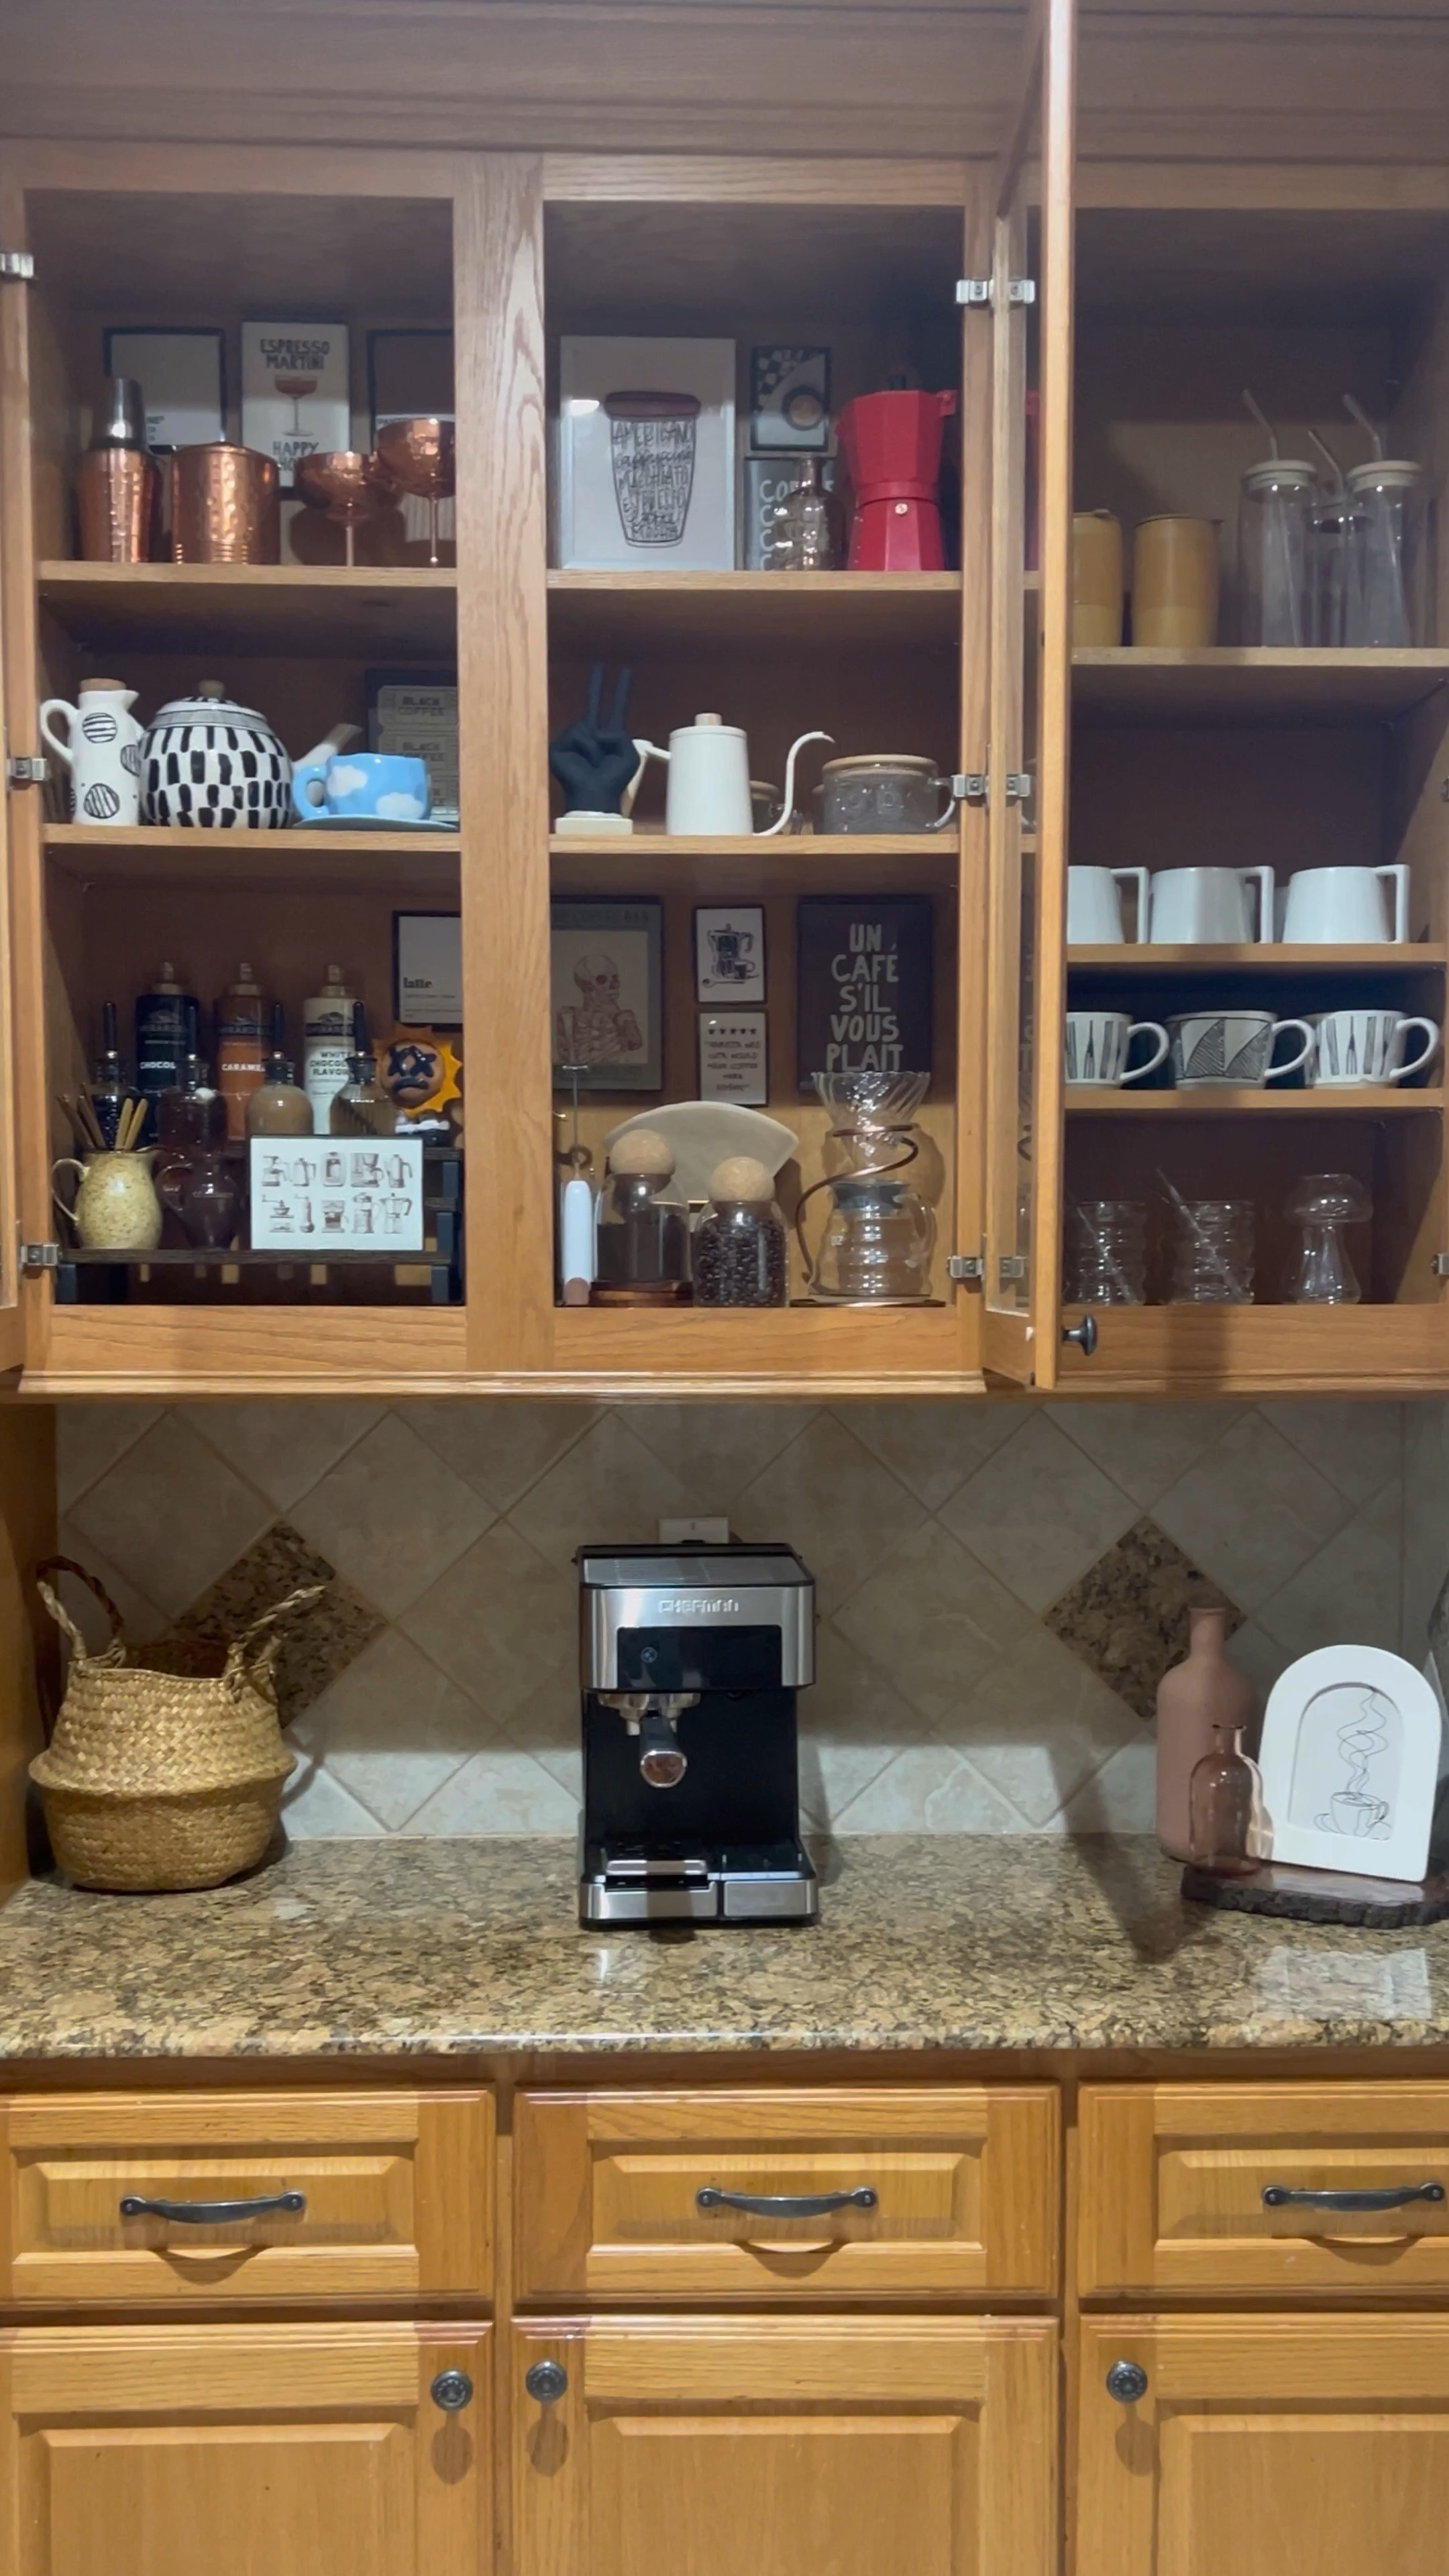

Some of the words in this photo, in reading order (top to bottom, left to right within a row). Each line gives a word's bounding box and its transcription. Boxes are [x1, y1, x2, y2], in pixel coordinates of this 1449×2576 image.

[260, 338, 330, 355] ESPRESSO
[266, 354, 325, 369] MARTINI
[272, 441, 319, 455] HAPPY
[403, 696, 441, 706] BLACK
[398, 706, 445, 716] COFFEE
[849, 923, 882, 953] UN
[831, 943, 900, 983] CAFÉ
[839, 982, 892, 1013] S'IL
[830, 1014, 900, 1042] VOUS
[139, 1061, 176, 1070] CHOCOL
[309, 1059, 347, 1067] CHOCOL
[826, 1043, 904, 1073] PLAIT
